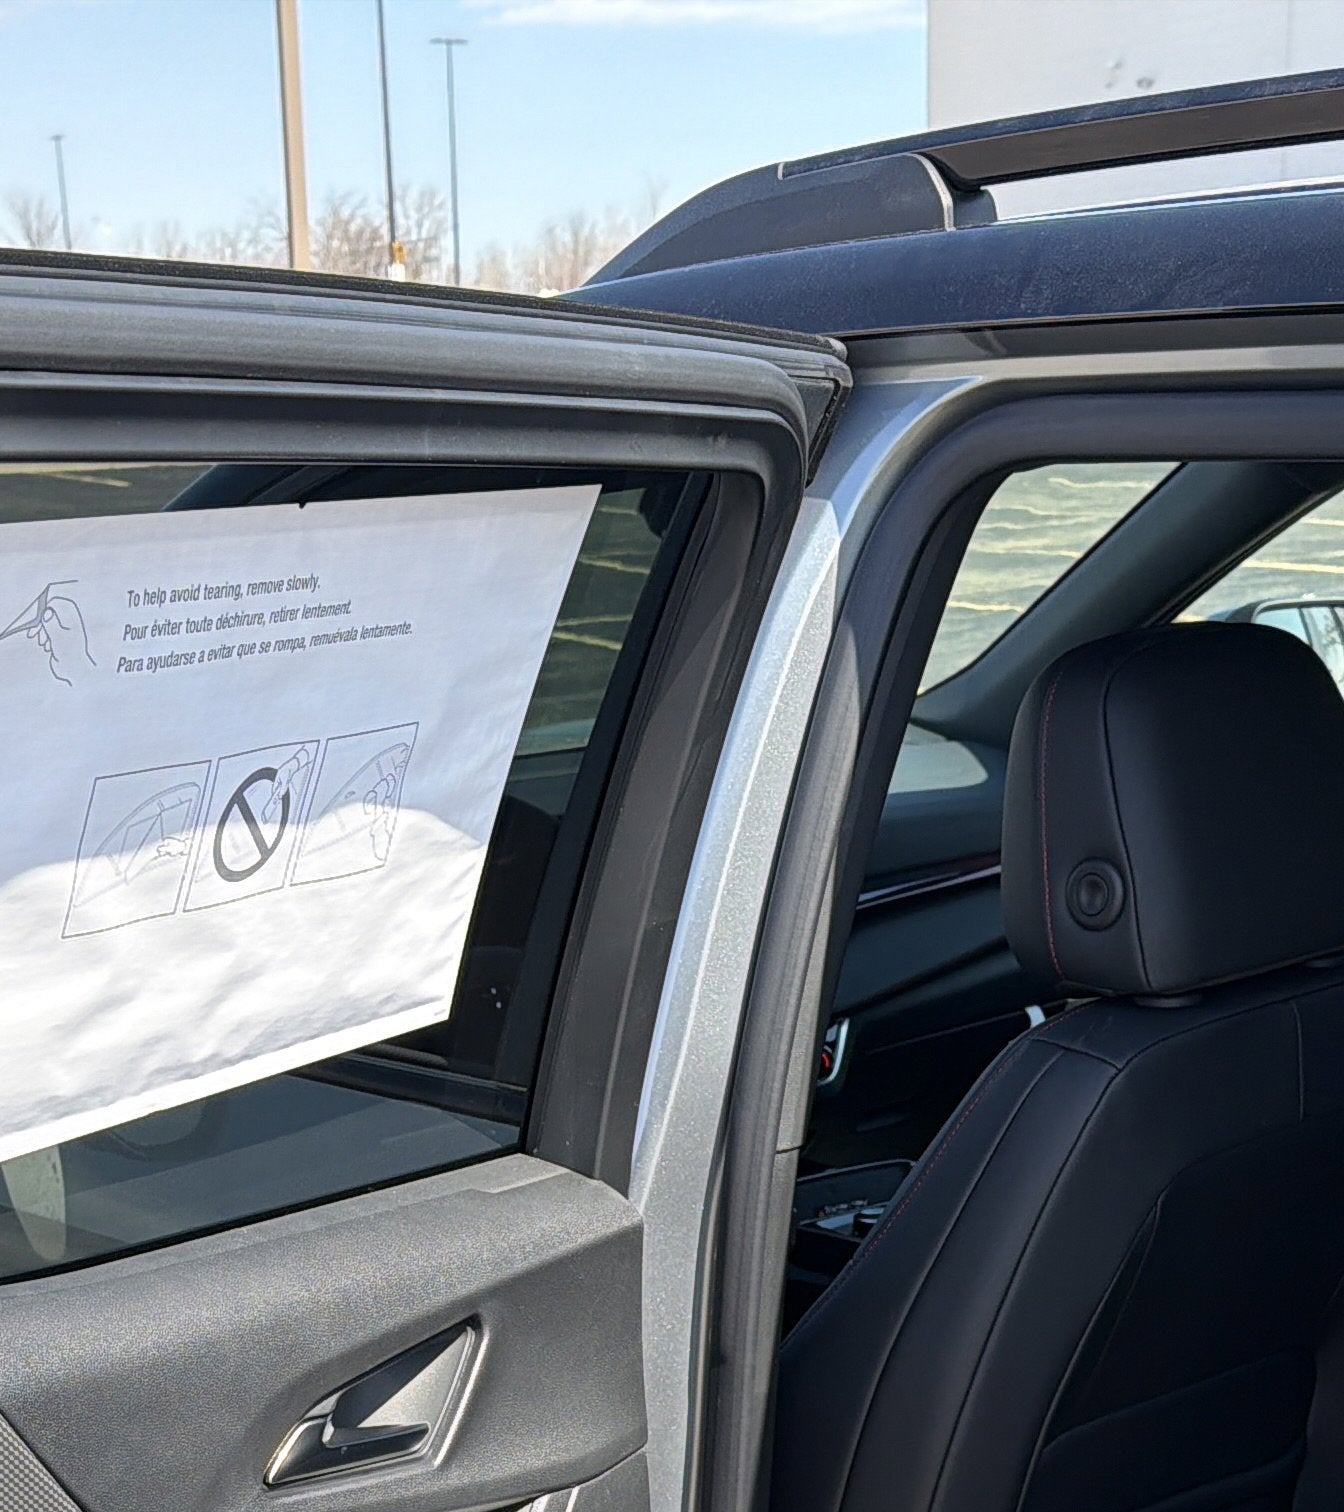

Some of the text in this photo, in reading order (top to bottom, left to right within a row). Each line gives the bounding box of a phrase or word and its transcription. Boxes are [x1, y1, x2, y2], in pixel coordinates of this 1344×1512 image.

[127, 573, 320, 608] To help avoid tearing, remove slowly.
[123, 600, 352, 641] Pour éviter toute déchirure, retirer lentement.
[117, 621, 413, 673] Para ayudarse a evitar que se rompa, remuévala lentamente.
